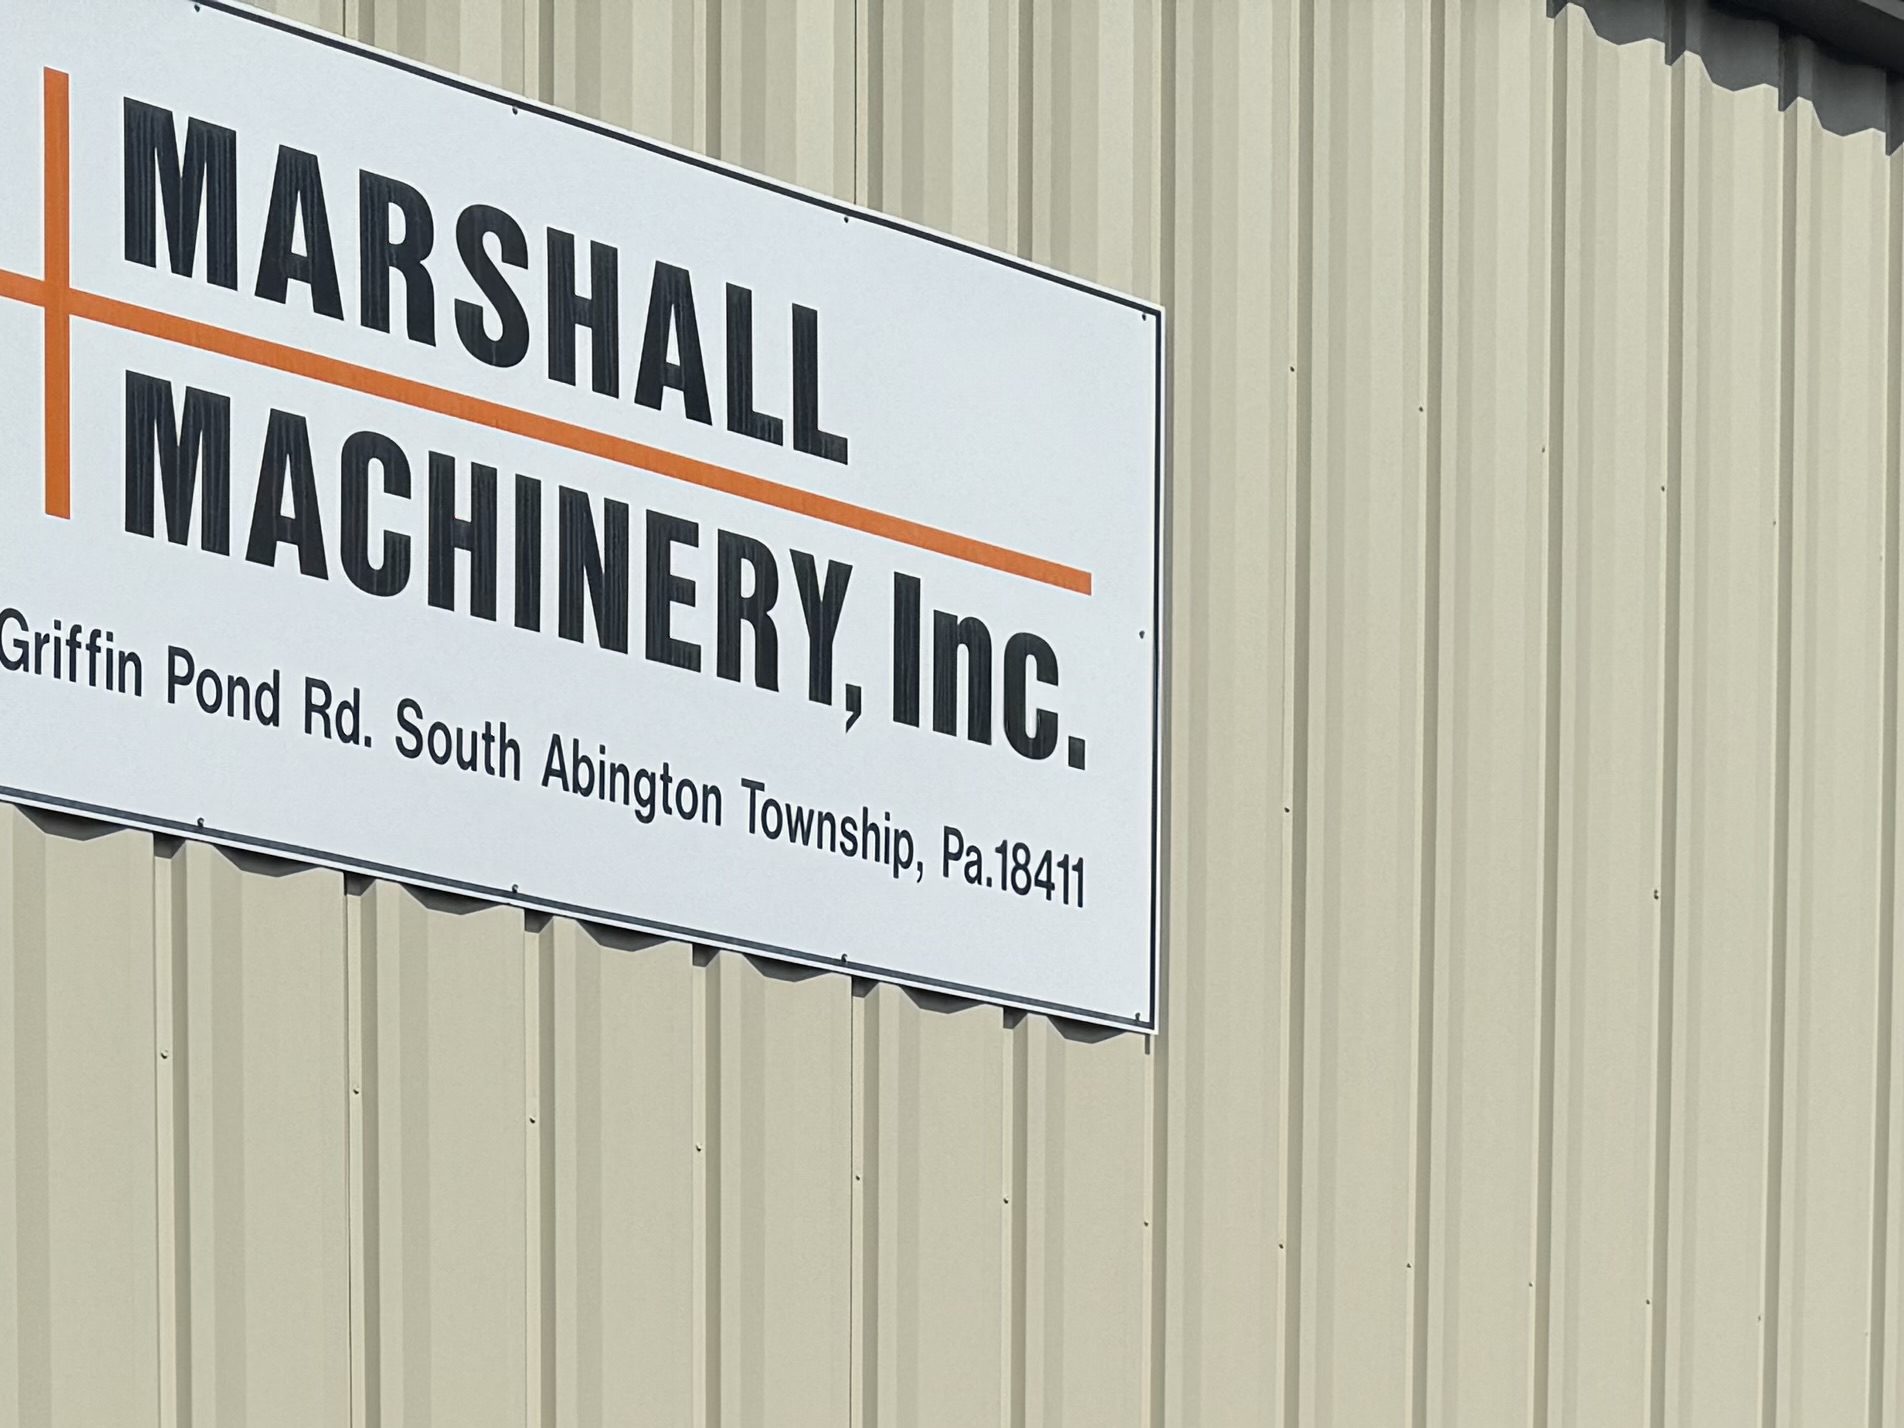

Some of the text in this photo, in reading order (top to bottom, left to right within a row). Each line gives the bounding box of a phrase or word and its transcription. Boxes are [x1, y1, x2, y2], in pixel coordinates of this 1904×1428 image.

[123, 96, 849, 466] MARSHALL
[124, 369, 1086, 771] MACHINERY, Inc.
[167, 645, 280, 728] Pond
[304, 676, 372, 748] Rd.
[395, 697, 521, 782] South
[541, 733, 722, 827] Abington
[741, 777, 923, 884] Township,
